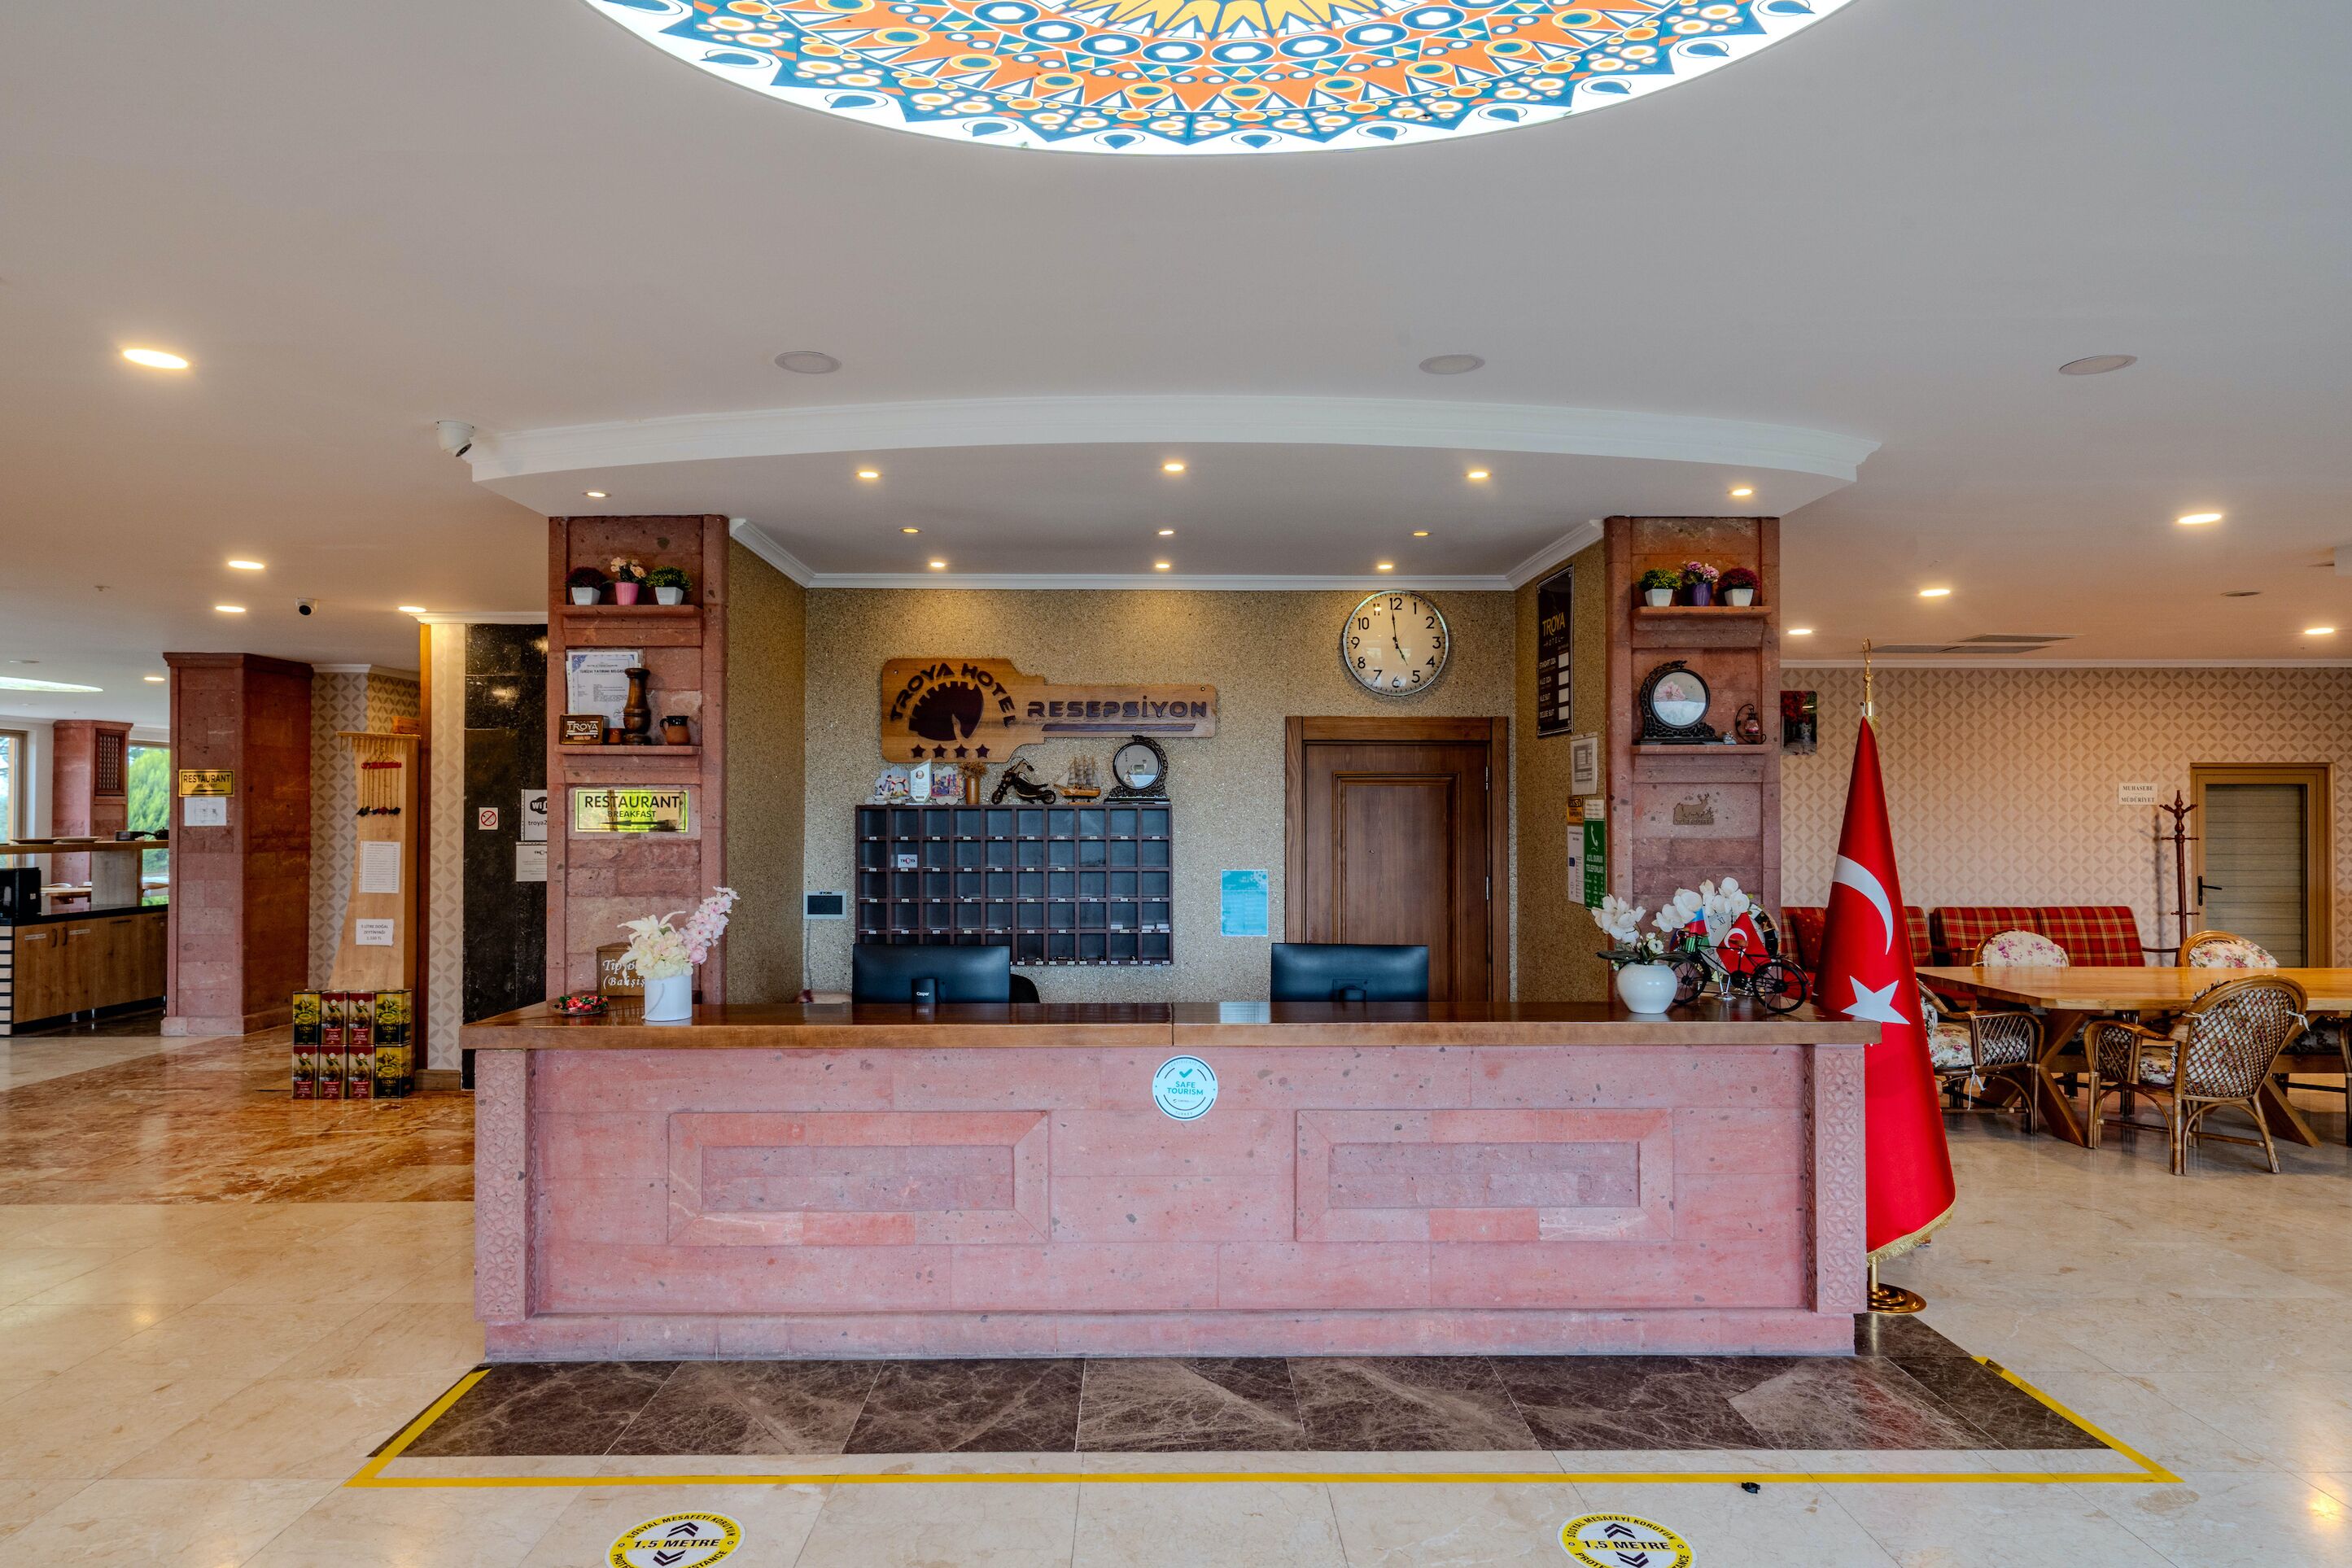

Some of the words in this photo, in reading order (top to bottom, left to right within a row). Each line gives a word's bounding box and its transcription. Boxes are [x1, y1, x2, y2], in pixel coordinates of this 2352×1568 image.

[1372, 603, 1382, 616] 11
[1389, 597, 1402, 610] 12
[1413, 601, 1417, 614] 1
[1357, 617, 1370, 630] 10
[1425, 616, 1435, 629] 2
[1541, 611, 1566, 636] TROYA
[1350, 636, 1360, 649] 9
[1432, 636, 1441, 649] 3
[1357, 656, 1366, 669] 8
[1426, 655, 1436, 667] 4
[1373, 669, 1383, 682] 7
[1391, 675, 1401, 688] 6
[1411, 670, 1421, 684] 5
[890, 662, 955, 723] TROYA
[960, 662, 1017, 728] HOTEL
[1027, 695, 1207, 718] RESEPSİYON
[567, 723, 598, 732] TROYA
[183, 775, 230, 783] RESTAURANT
[584, 796, 680, 808] RESTAURANT
[602, 959, 622, 975] Tip
[1167, 1087, 1204, 1095] TOURISM
[626, 1521, 660, 1539] SOSYAL
[662, 1514, 711, 1524] MESAFEYİ
[710, 1517, 736, 1537] KORUYUN
[1567, 1521, 1586, 1538] SOSYAL
[1584, 1516, 1631, 1525] MESAFEYİ
[1633, 1518, 1677, 1540] KORUYUN
[662, 1539, 721, 1548] METRE
[1614, 1541, 1671, 1550] METRE
